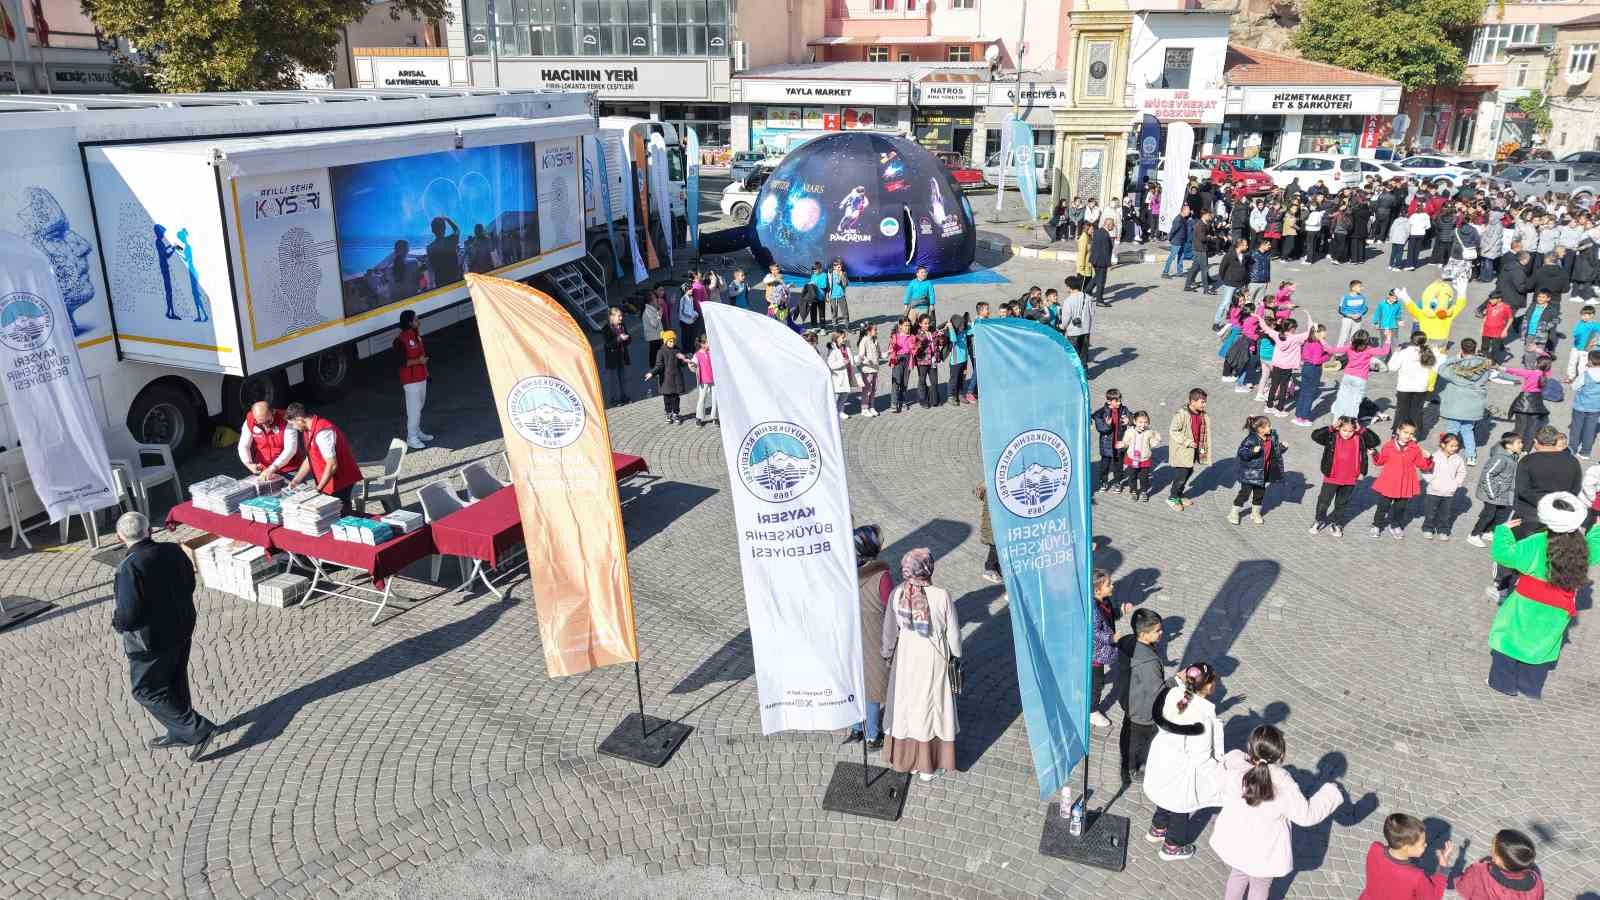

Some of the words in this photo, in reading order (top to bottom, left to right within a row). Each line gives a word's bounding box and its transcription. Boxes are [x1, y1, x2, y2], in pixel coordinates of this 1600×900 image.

[541, 69, 601, 81] HACININ
[604, 66, 638, 81] YERİ
[785, 87, 813, 96] YAYLA
[814, 88, 852, 96] MARKET
[1272, 101, 1284, 109] ET
[1287, 101, 1294, 109] &
